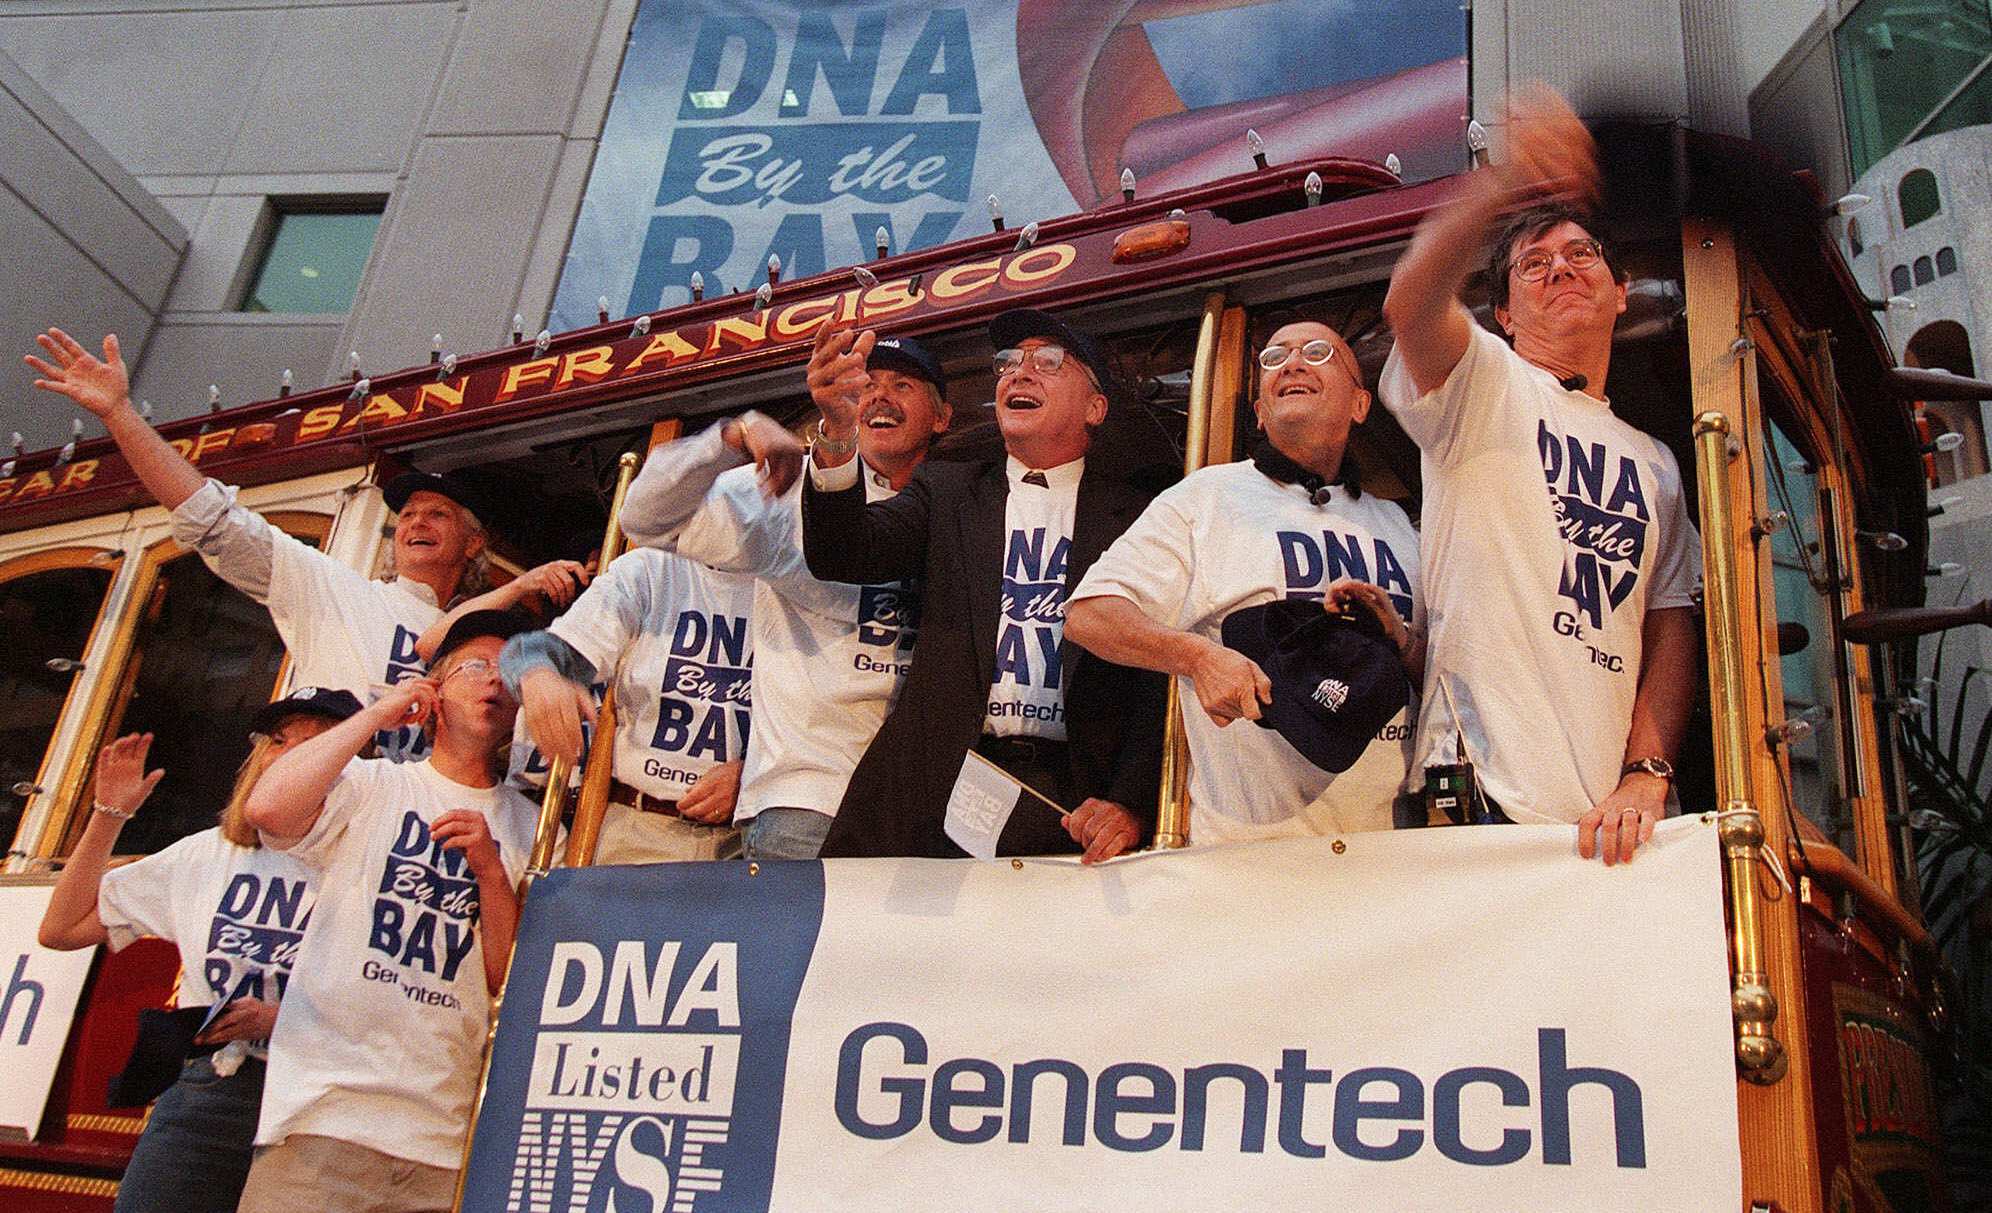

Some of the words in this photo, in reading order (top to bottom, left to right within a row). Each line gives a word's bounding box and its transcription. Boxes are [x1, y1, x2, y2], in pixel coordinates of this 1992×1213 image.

[677, 3, 983, 121] DNA
[694, 133, 804, 210] By
[828, 132, 949, 194] the
[297, 376, 471, 443] SAN
[497, 243, 1078, 403] FRANCISCO
[1537, 418, 1650, 523] DNA
[1006, 528, 1073, 582] NA
[1276, 530, 1413, 595] DNA
[1587, 521, 1635, 557] the
[669, 610, 754, 668] DN
[676, 665, 717, 701] By
[216, 873, 318, 931] DN
[391, 861, 436, 905] By
[368, 897, 475, 982] BAY
[539, 940, 742, 1028] DNA
[548, 1042, 715, 1104] Listed
[834, 1021, 1647, 1169] Genentech
[506, 1112, 730, 1213] NYSE
